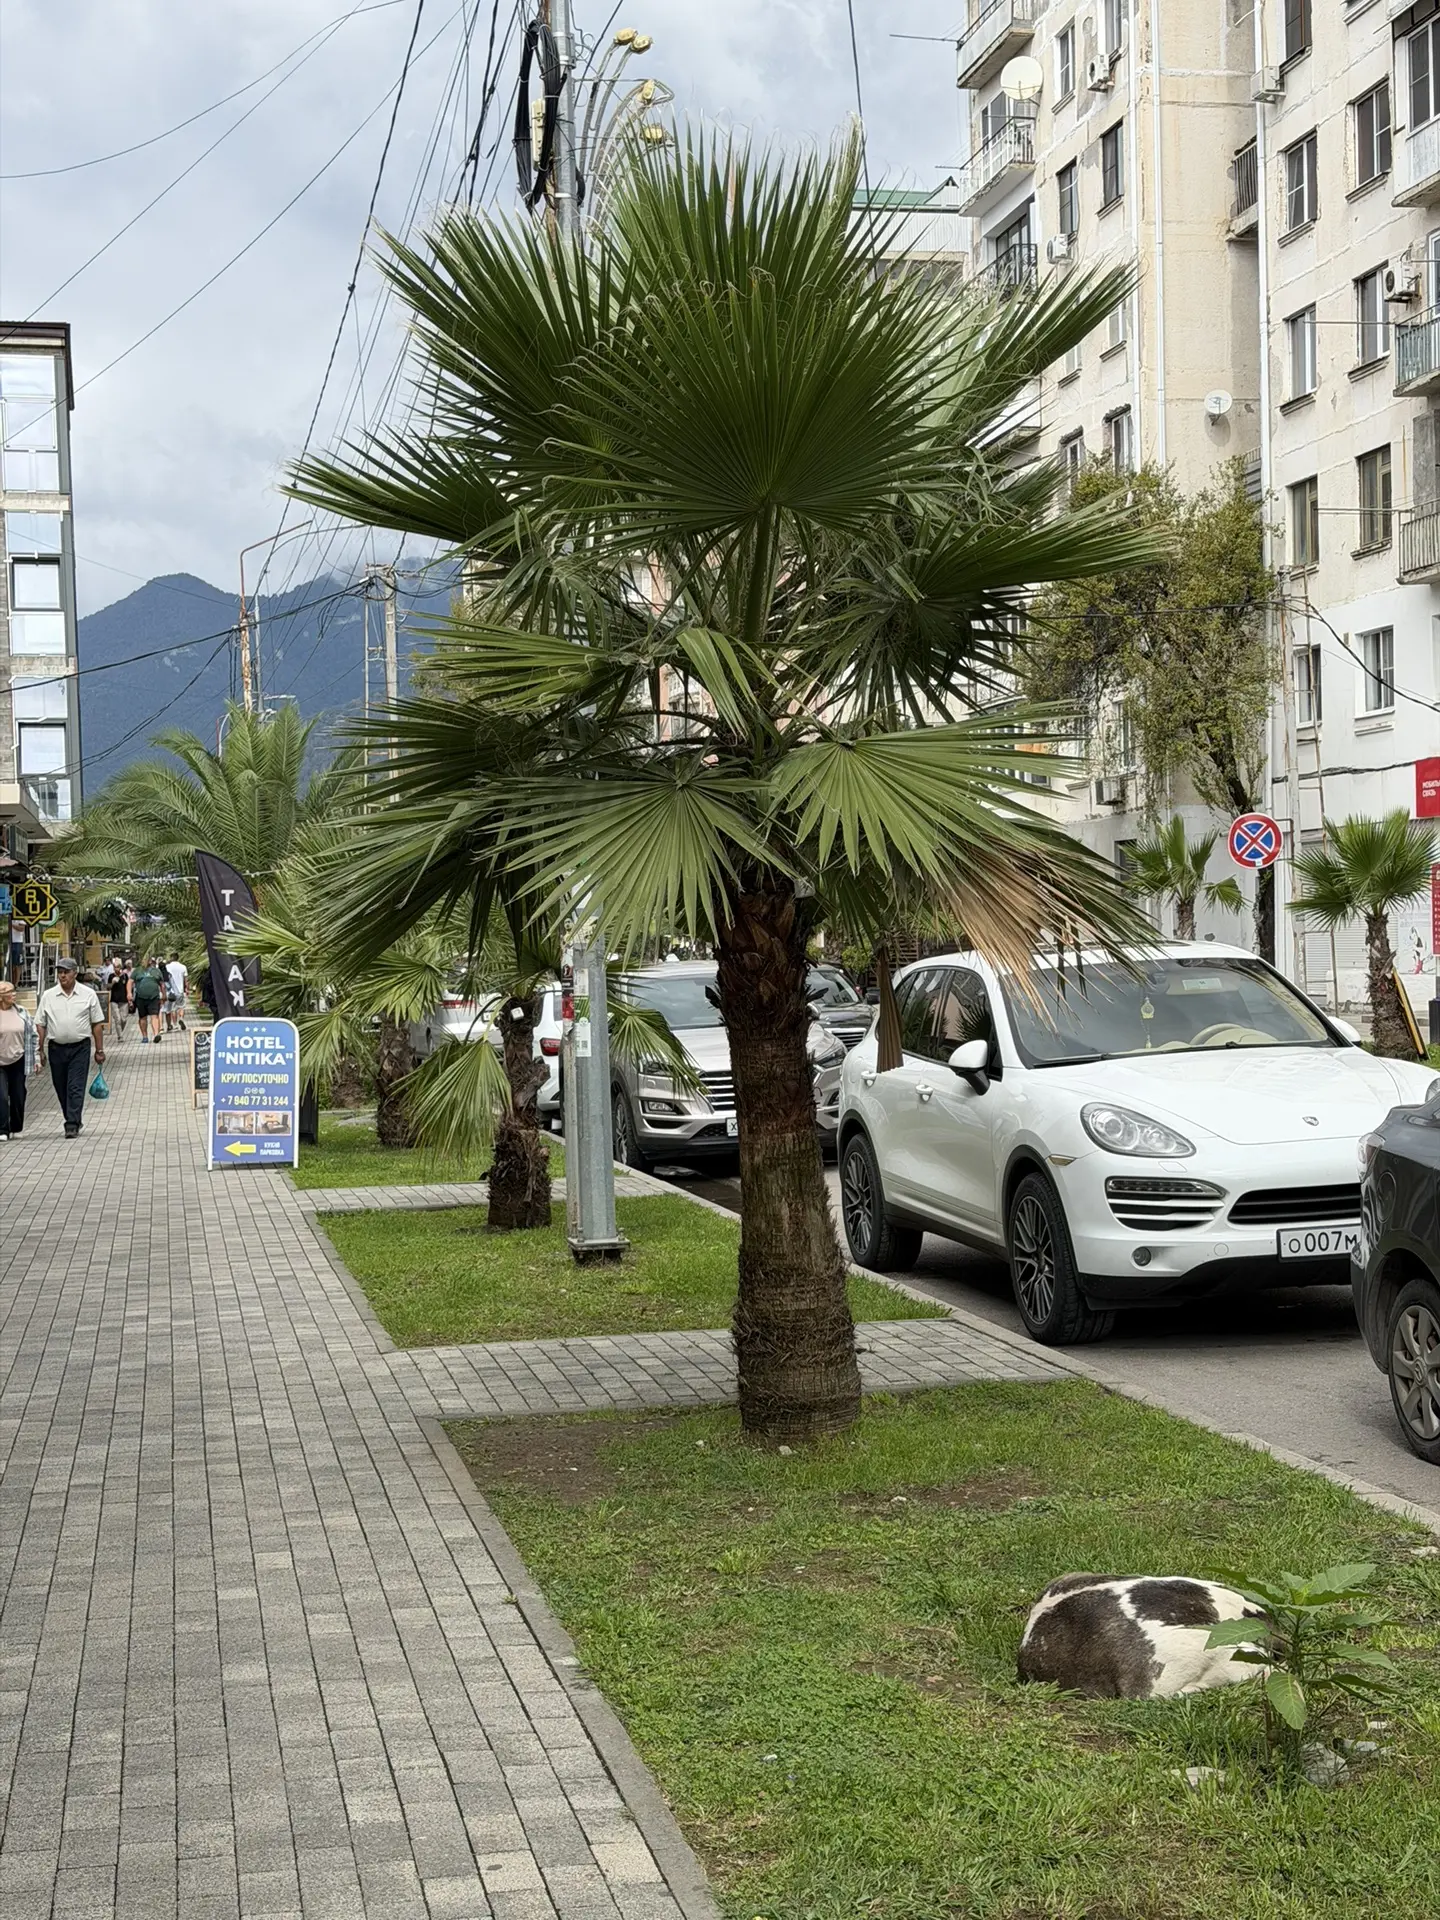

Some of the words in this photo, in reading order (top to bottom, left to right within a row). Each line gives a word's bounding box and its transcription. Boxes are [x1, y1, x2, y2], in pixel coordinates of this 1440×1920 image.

[226, 1036, 286, 1049] HOTEL
[218, 1052, 294, 1065] "NITIKA"
[221, 1072, 290, 1084] КРУГЛОСУТОЧНО
